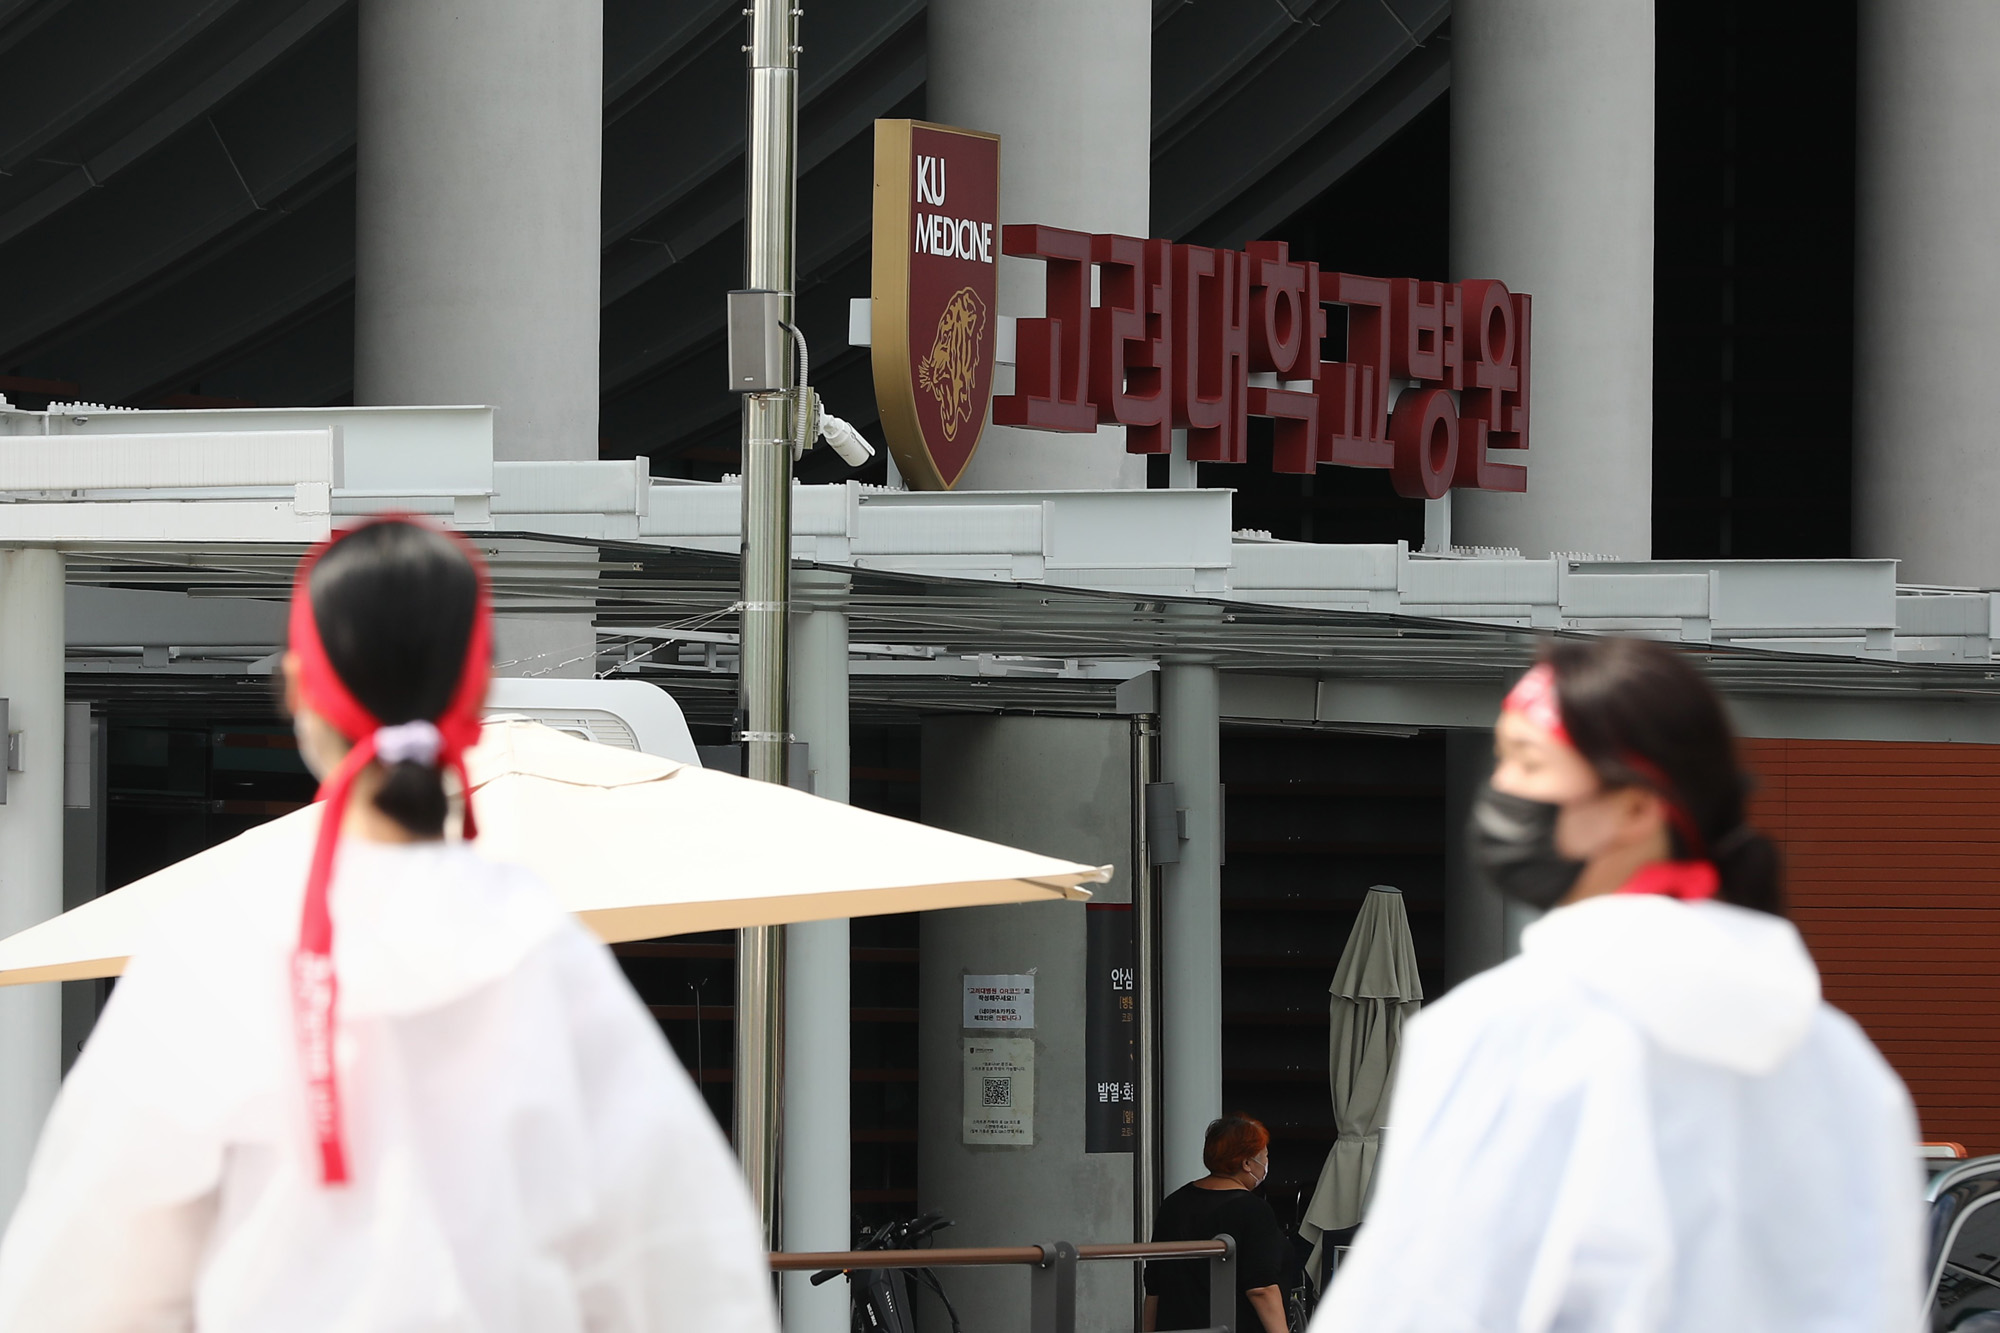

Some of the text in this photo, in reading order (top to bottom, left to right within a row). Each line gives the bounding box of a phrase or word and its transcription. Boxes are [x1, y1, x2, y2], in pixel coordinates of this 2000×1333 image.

[916, 155, 946, 206] KU
[914, 212, 994, 264] MEDICINE
[993, 224, 1532, 499] 고려대학교병원
